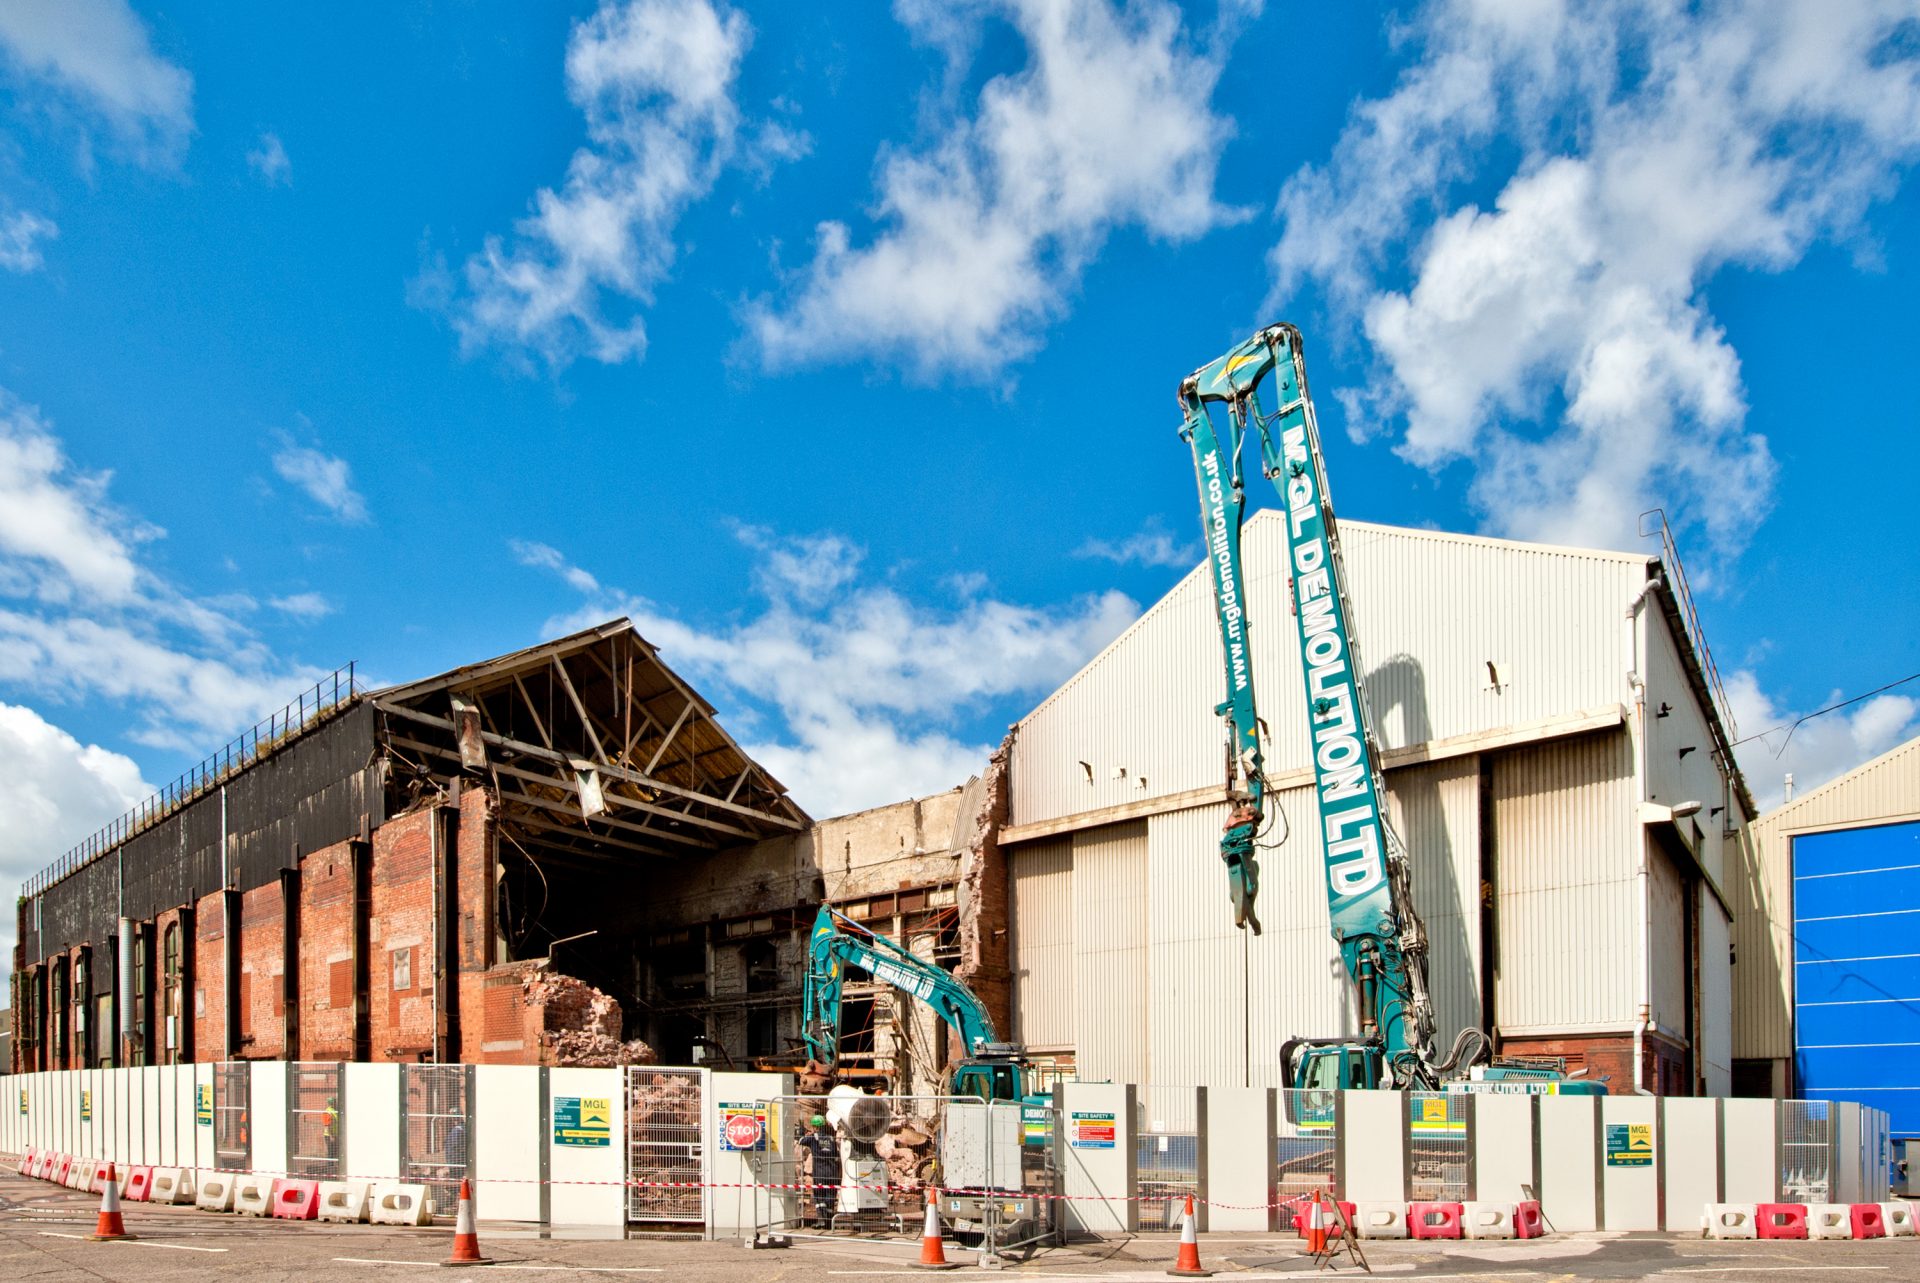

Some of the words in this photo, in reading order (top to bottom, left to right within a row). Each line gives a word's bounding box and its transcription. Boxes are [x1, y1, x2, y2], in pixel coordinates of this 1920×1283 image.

[1283, 424, 1317, 539] MGL
[1202, 449, 1247, 691] www.mgldemolition.co.uk
[1293, 538, 1368, 803] DEMOLITION
[1325, 804, 1382, 897] LTD
[916, 975, 936, 1000] LTD
[1530, 1083, 1549, 1095] LTD
[583, 1099, 607, 1109] MGL
[728, 1125, 759, 1136] STOP
[1631, 1125, 1649, 1134] MGL
